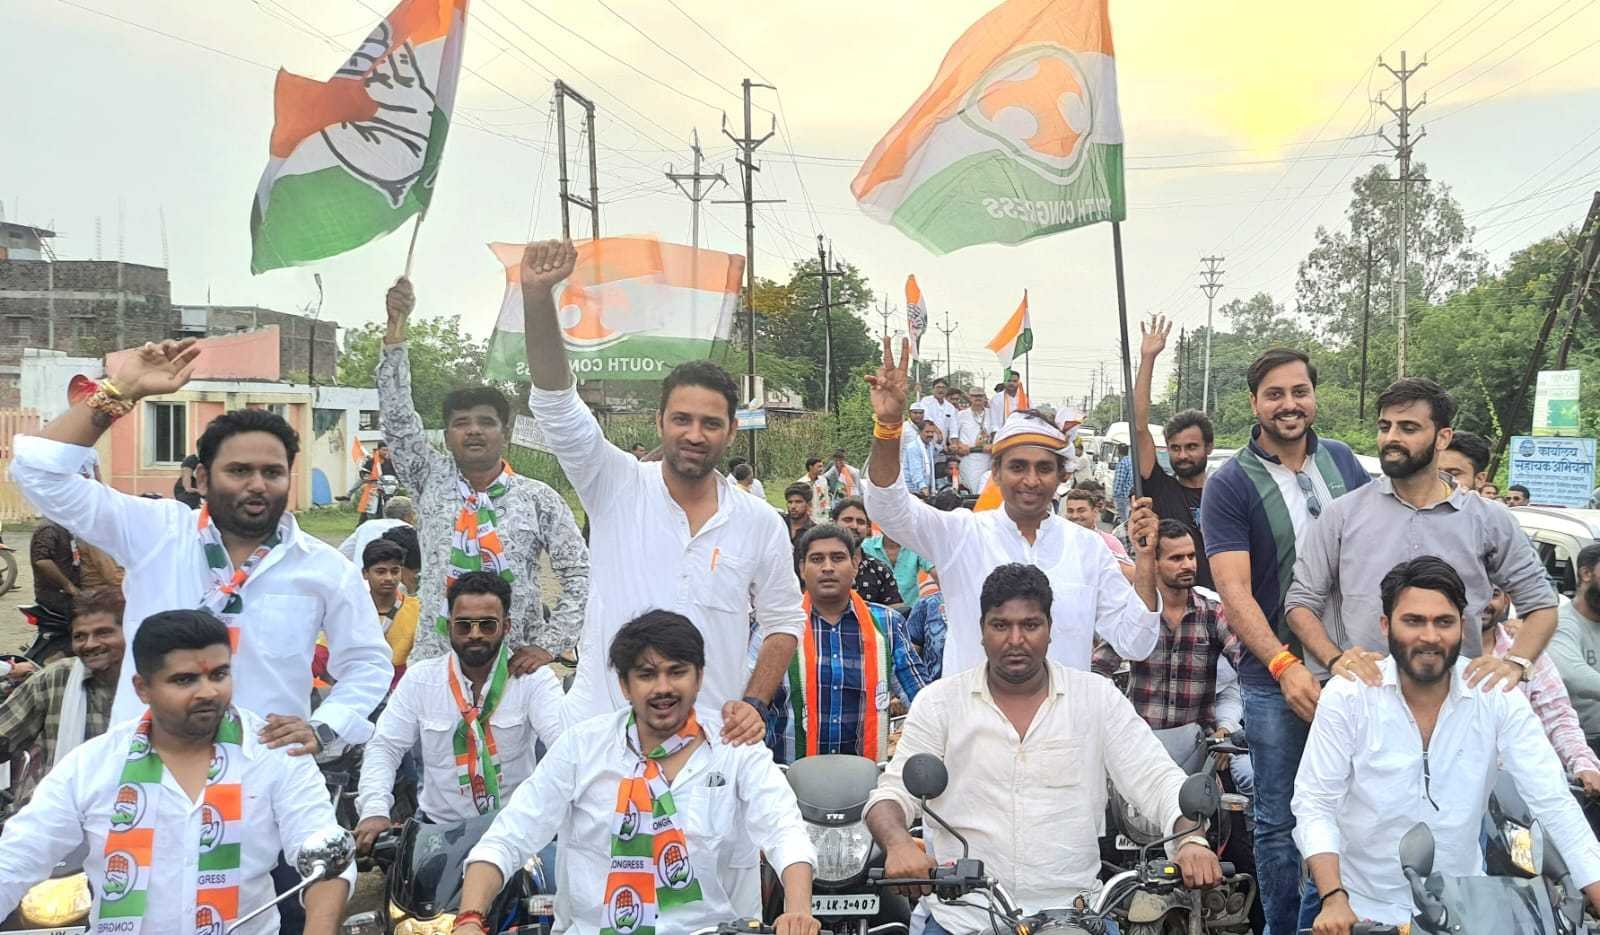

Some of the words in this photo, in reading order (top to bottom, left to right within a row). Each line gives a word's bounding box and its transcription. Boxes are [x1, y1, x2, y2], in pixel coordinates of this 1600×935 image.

[1537, 443, 1578, 457] कार्यालय
[611, 859, 645, 870] ONGRESS
[198, 873, 226, 885] GRESS
